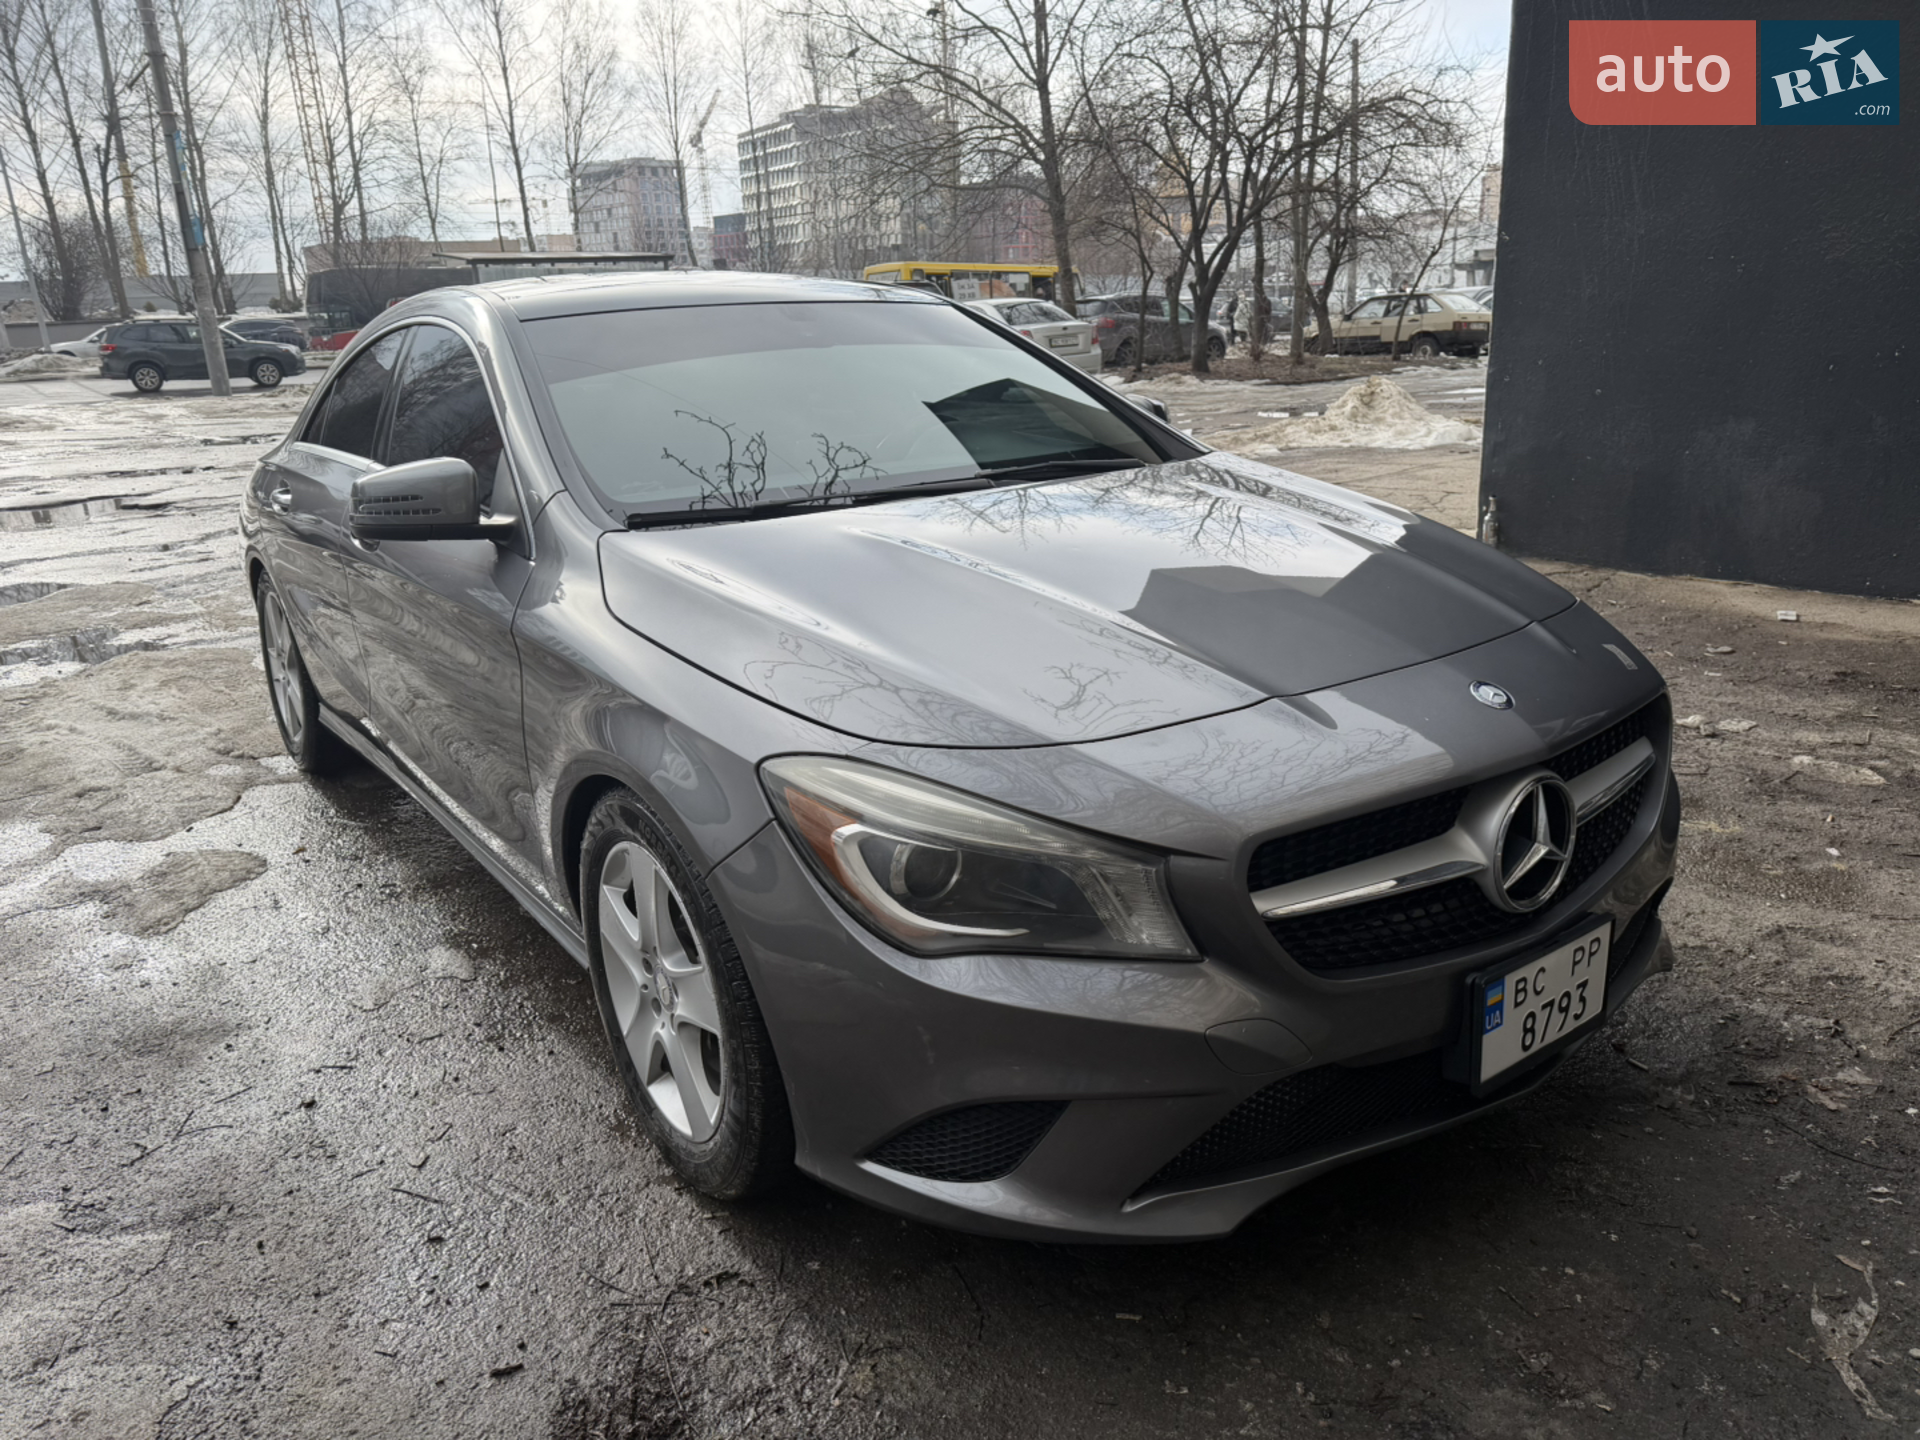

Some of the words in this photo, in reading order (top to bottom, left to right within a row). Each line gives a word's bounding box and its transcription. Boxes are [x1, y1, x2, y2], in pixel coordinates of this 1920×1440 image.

[1513, 966, 1546, 1009] BC
[1571, 936, 1602, 977] PP
[1485, 1010, 1501, 1030] UA
[1521, 977, 1589, 1053] 8793
